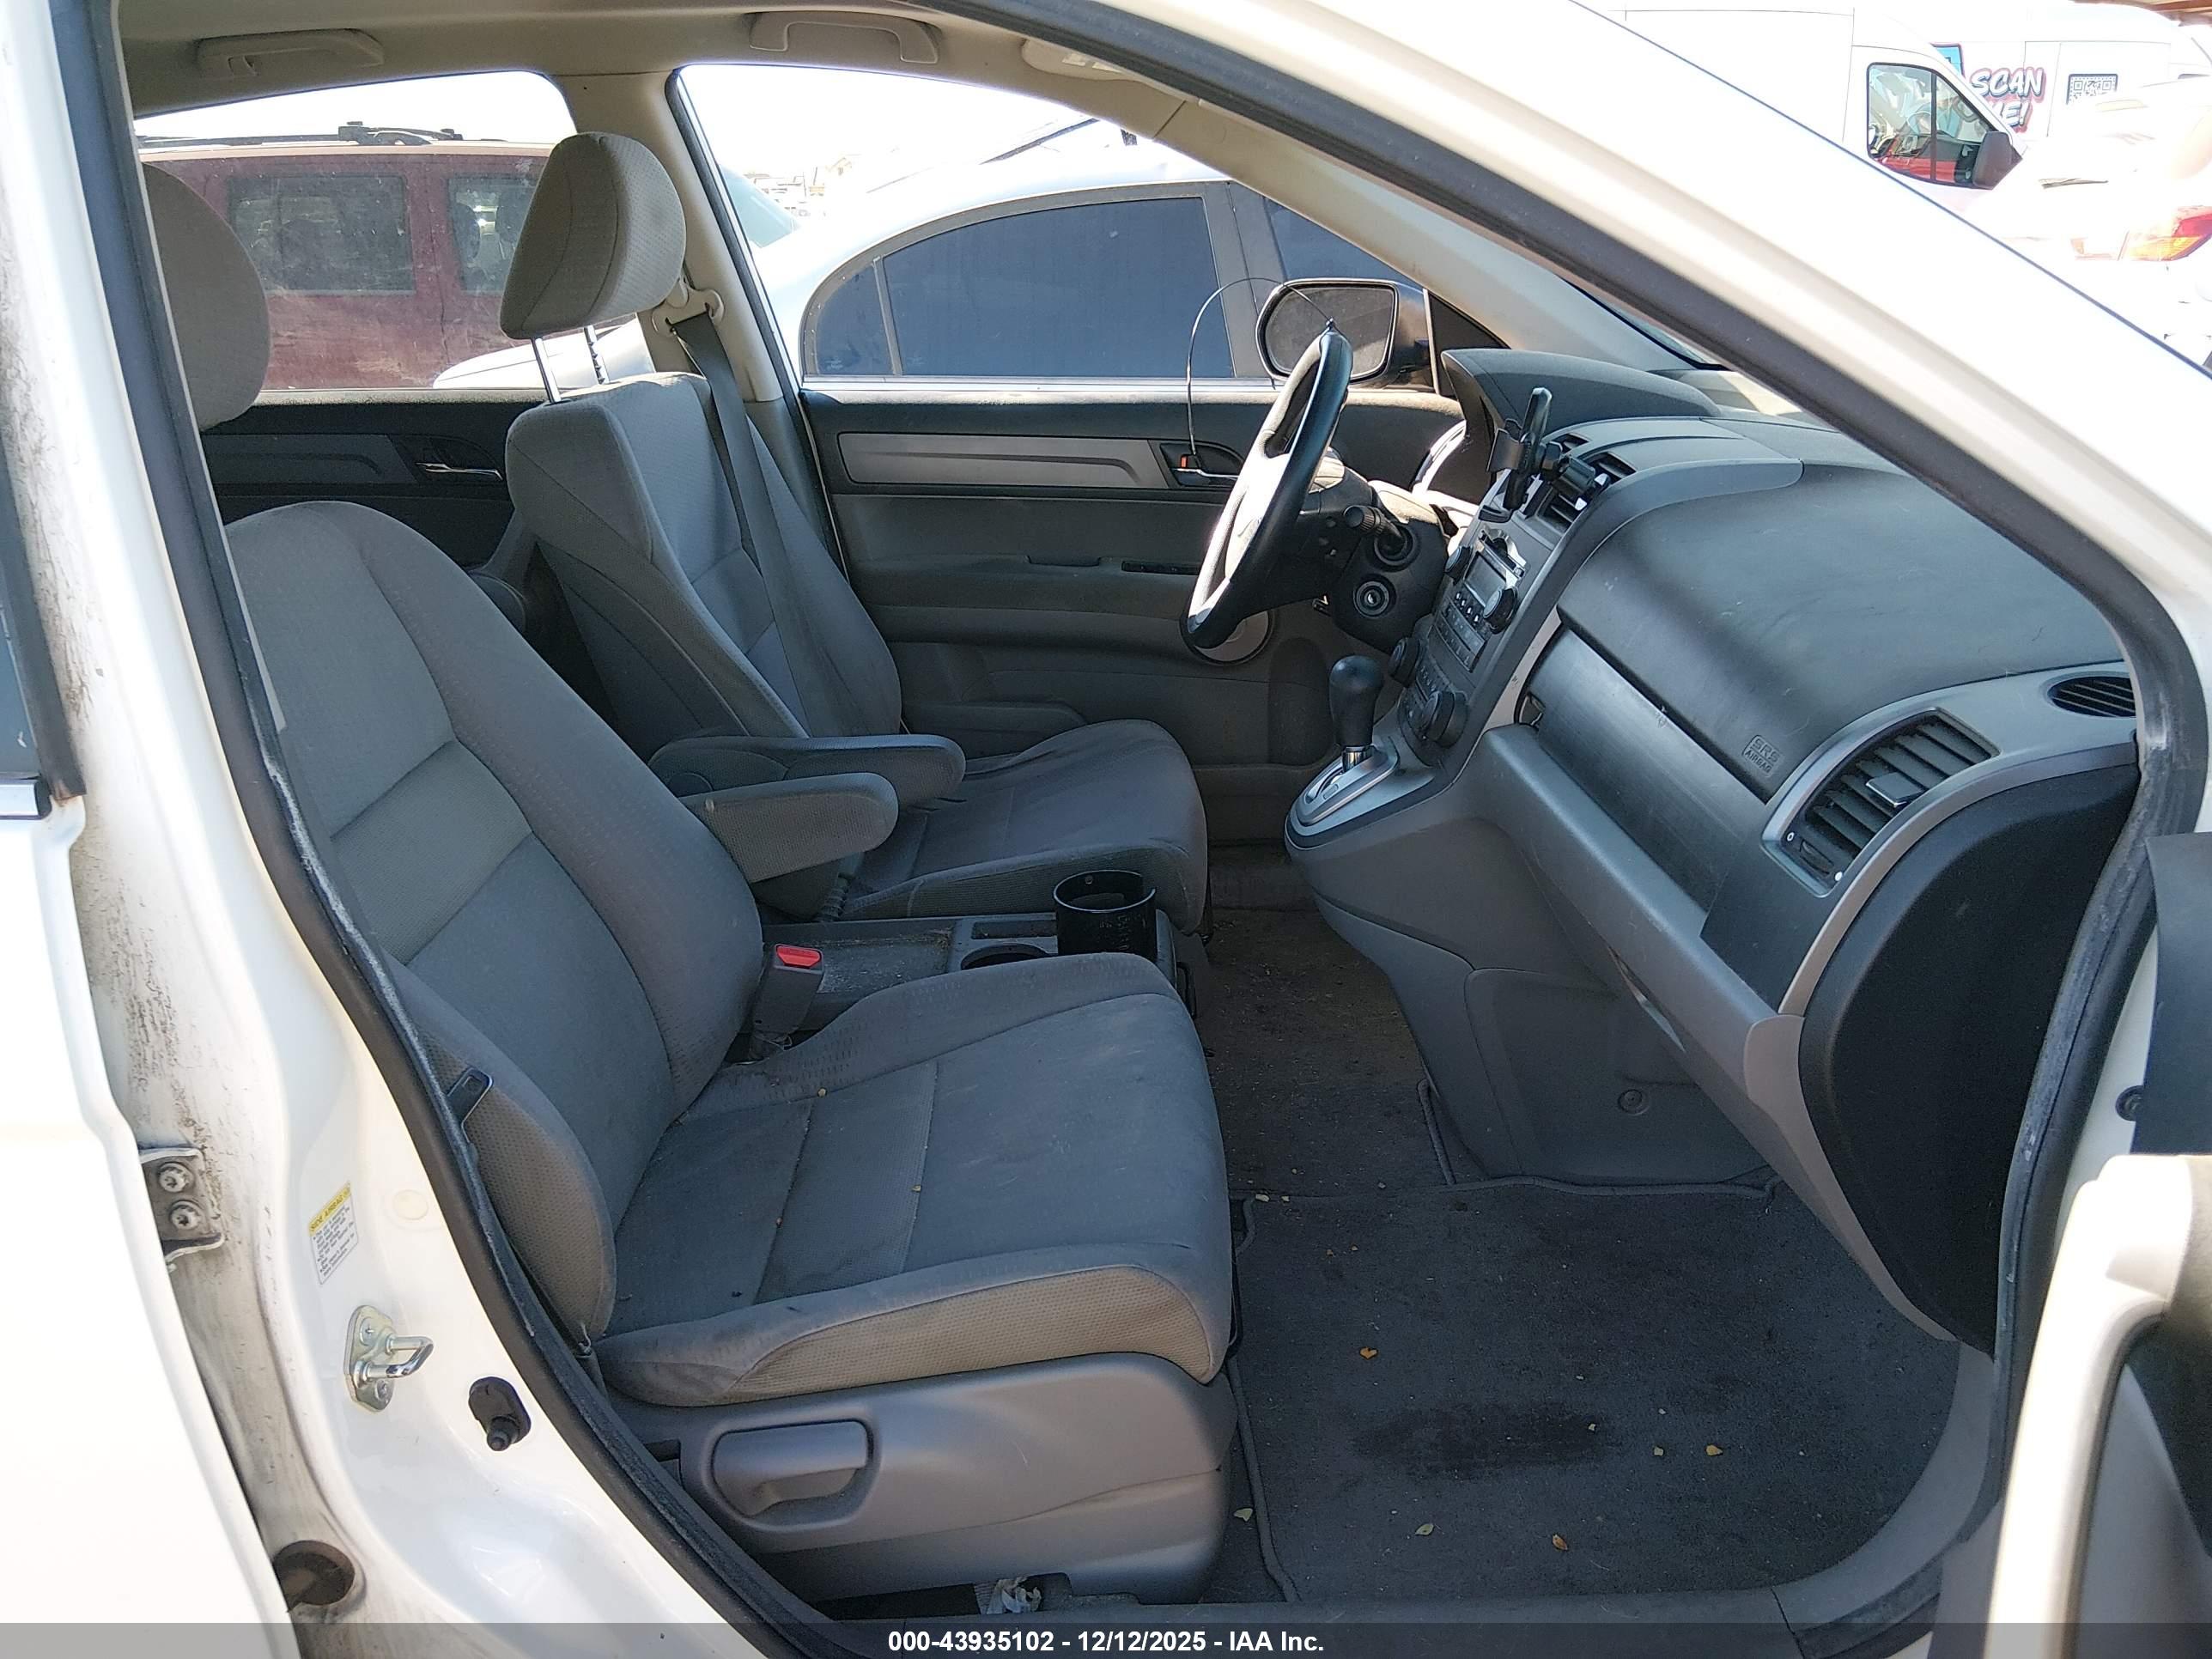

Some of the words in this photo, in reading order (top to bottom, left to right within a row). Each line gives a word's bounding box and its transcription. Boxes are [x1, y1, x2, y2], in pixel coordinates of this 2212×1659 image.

[1972, 67, 2045, 98] SCAN
[1745, 750, 1772, 773] AIRBAG
[1753, 738, 1778, 763] SRS
